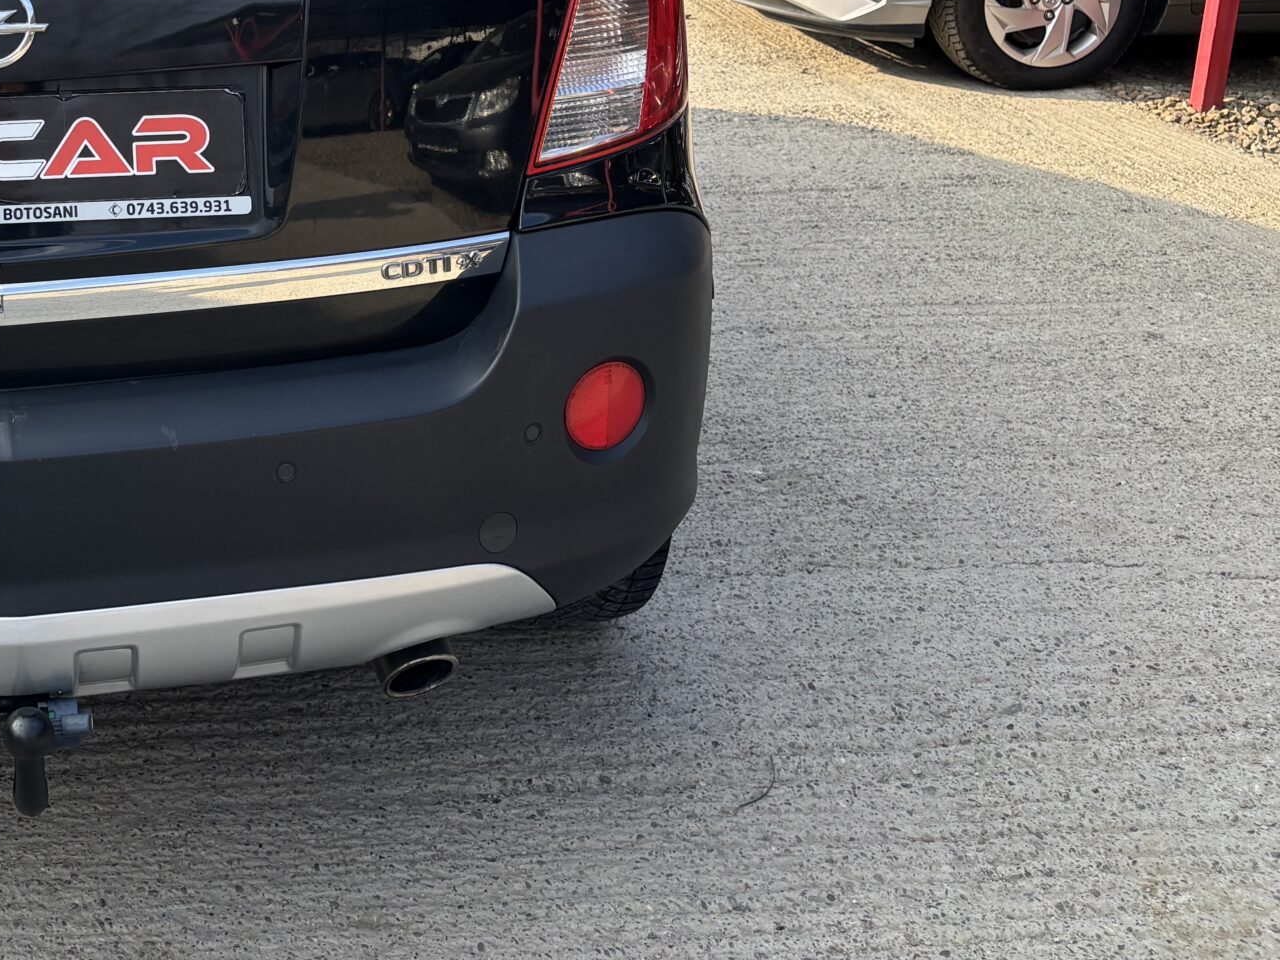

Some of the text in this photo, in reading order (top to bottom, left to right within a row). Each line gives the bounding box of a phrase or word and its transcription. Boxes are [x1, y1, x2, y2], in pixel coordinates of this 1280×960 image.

[3, 205, 79, 220] BOTOSANI
[126, 200, 232, 216] 0743.639.931
[380, 255, 452, 280] CDTI
